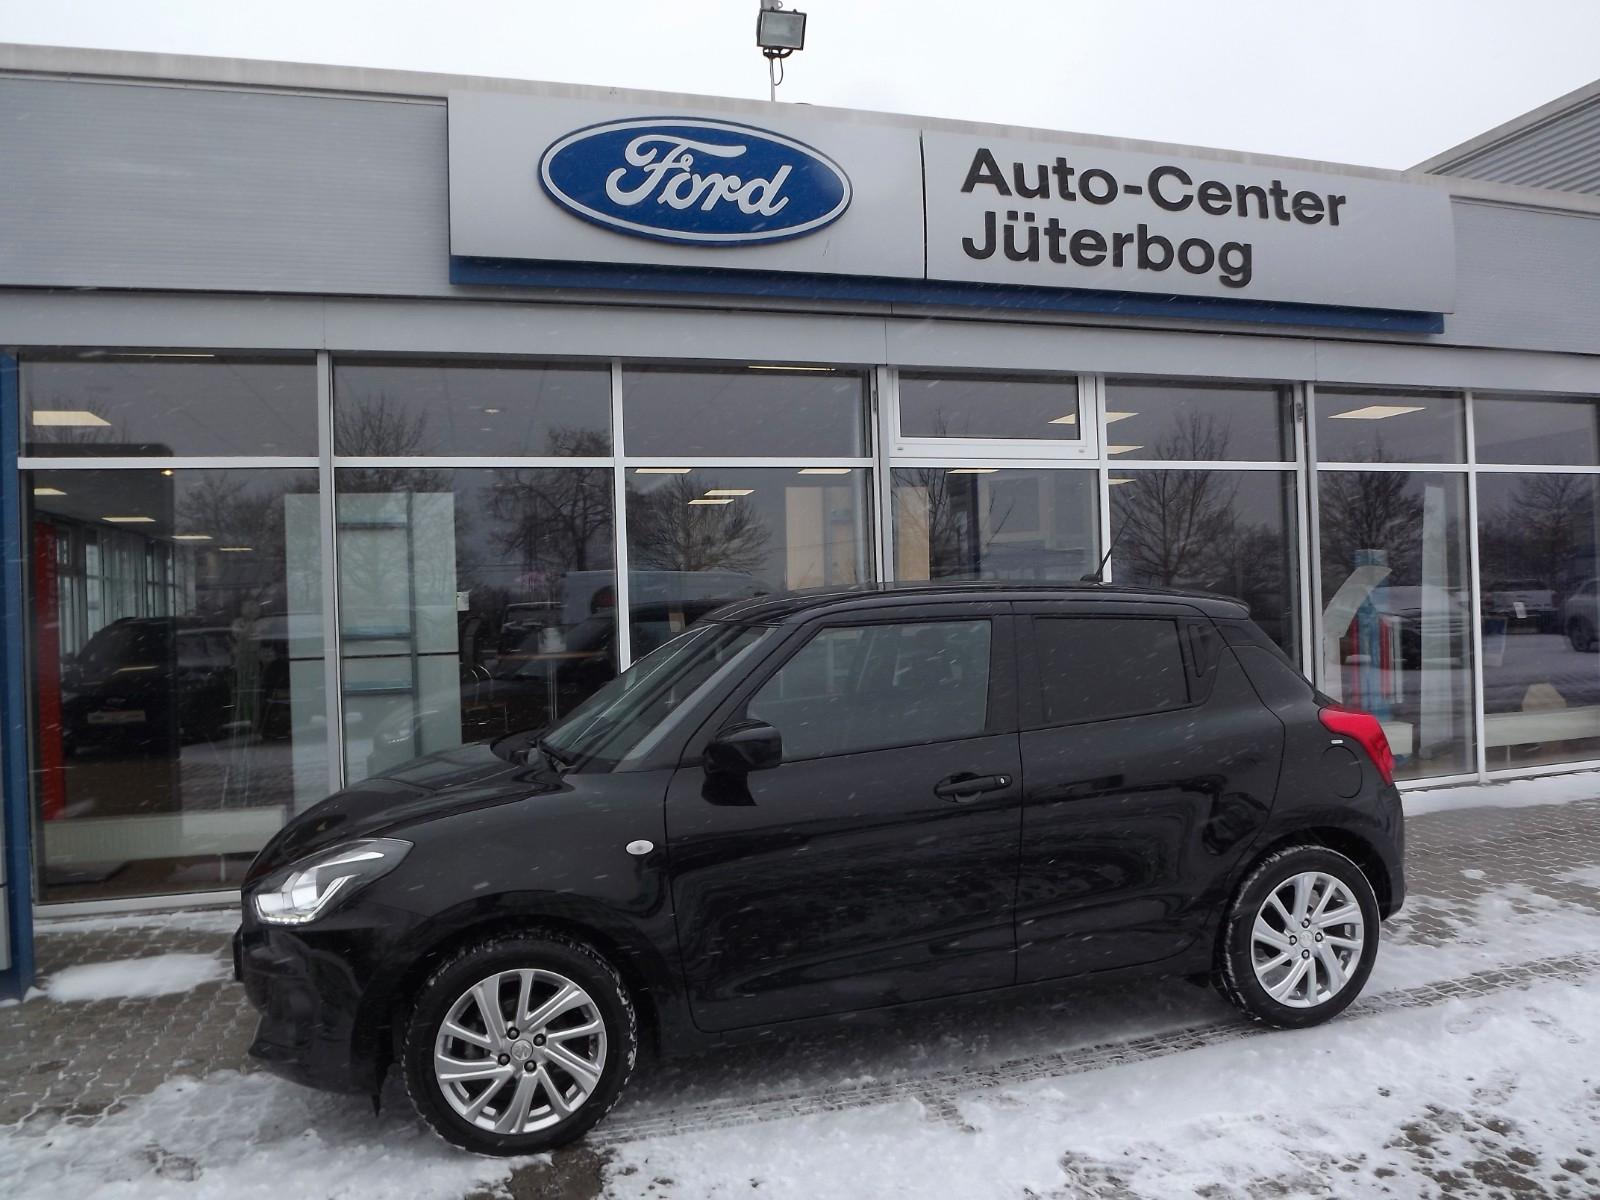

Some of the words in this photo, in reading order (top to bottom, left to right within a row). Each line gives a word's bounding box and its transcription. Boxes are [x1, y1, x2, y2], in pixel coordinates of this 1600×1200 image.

[605, 133, 792, 217] Ford
[960, 147, 1346, 227] Auto-Center
[961, 210, 1253, 289] Jüterbog
